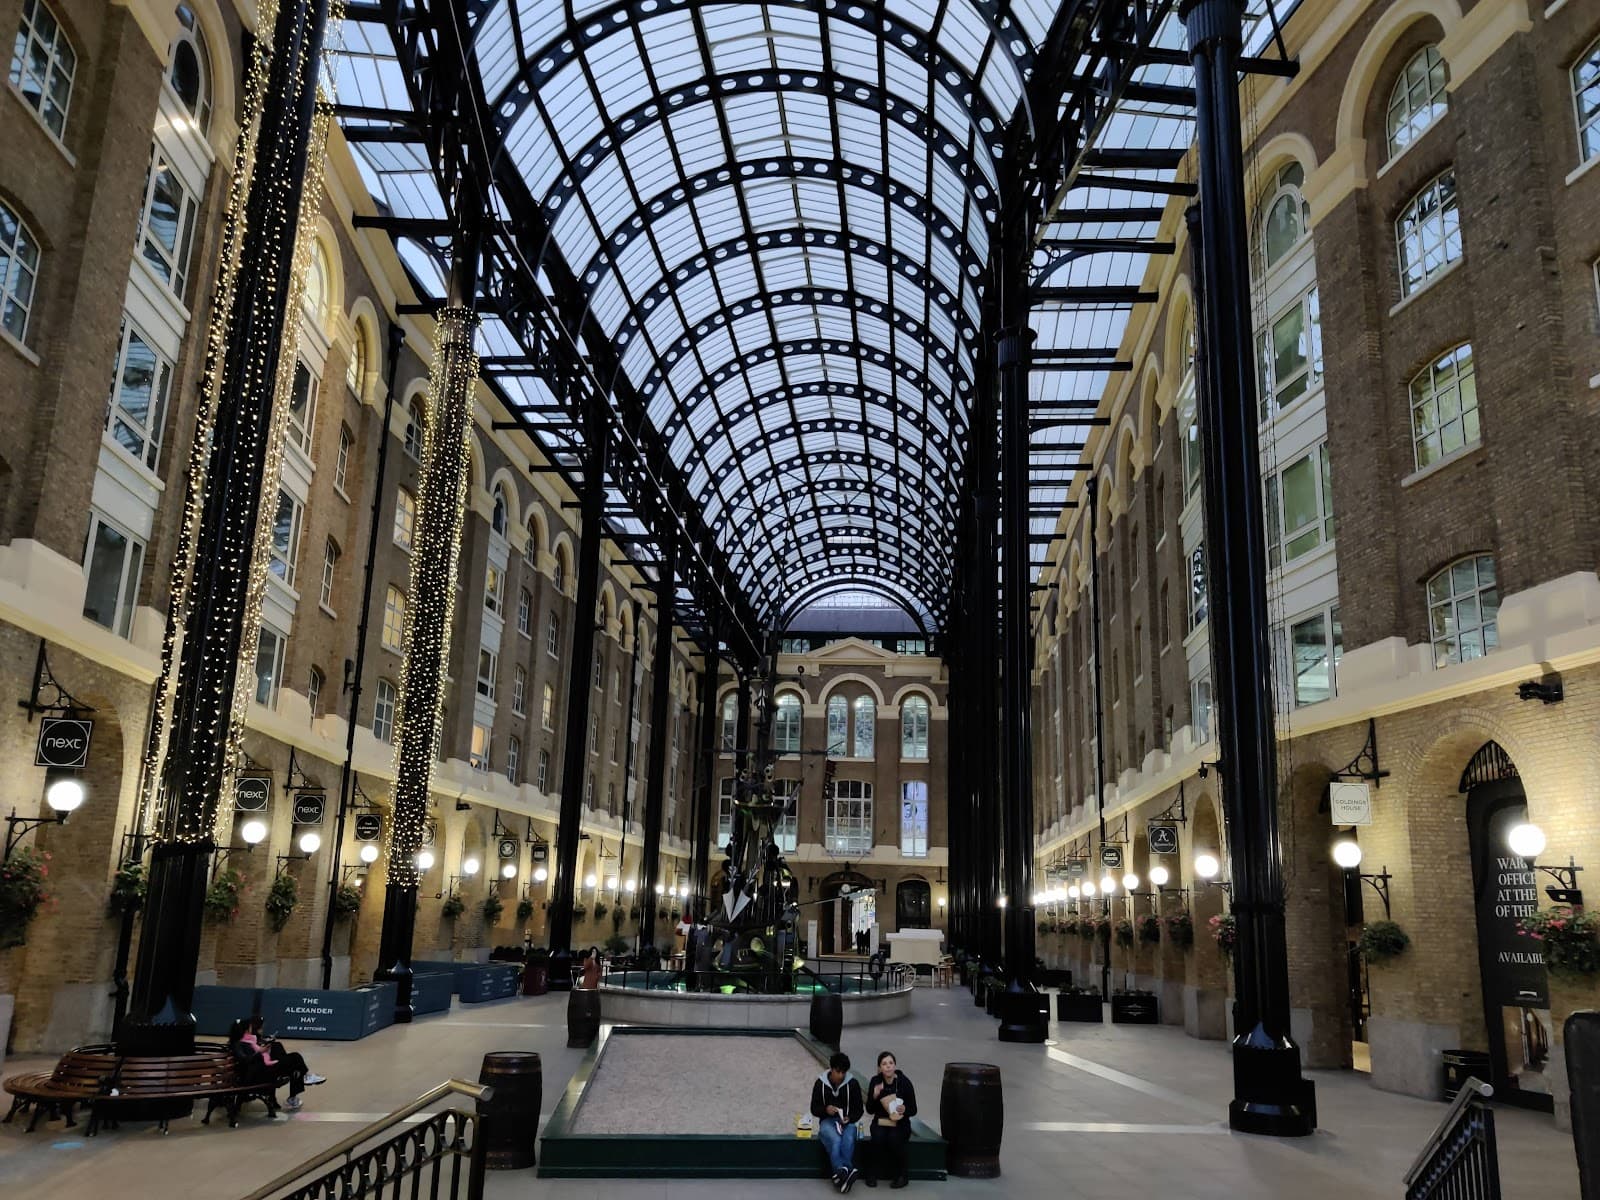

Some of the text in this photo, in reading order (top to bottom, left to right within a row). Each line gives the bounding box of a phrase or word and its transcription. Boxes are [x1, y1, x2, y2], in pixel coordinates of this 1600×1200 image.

[45, 737, 82, 749] next
[238, 790, 265, 799] next
[297, 806, 319, 814] next
[1497, 888, 1537, 902] AT THE
[1495, 904, 1510, 918] OF
[1498, 951, 1546, 964] AVAILABL
[285, 1007, 334, 1015] ALEXANDER
